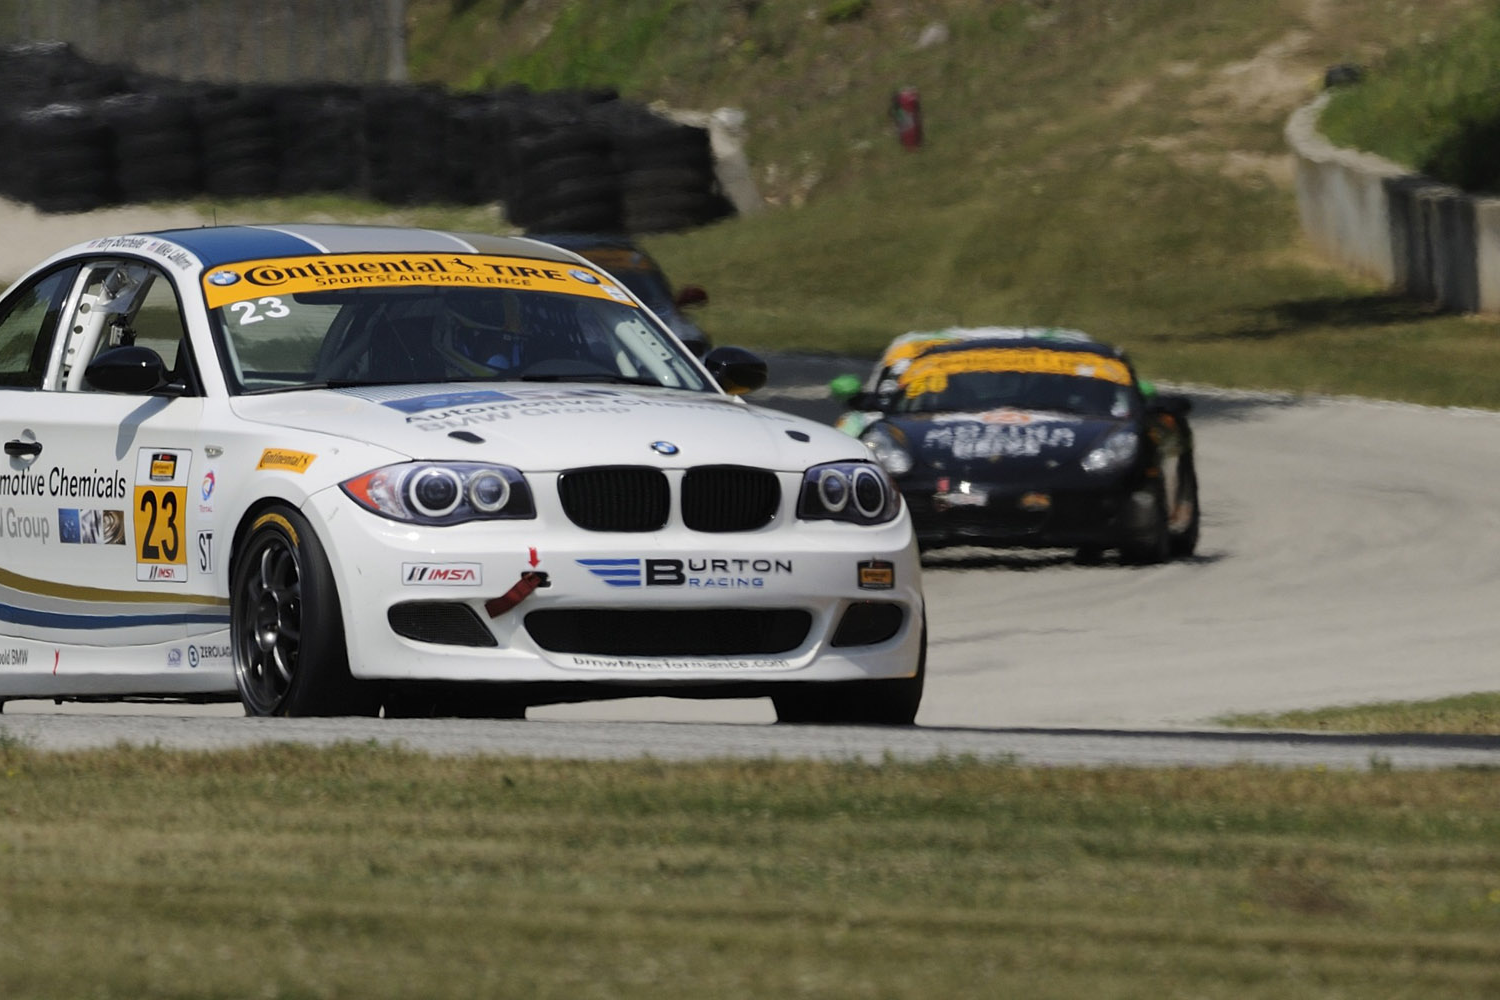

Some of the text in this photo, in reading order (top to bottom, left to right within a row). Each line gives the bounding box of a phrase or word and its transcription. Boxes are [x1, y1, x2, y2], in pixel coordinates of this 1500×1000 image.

[243, 258, 568, 287] Continental TIRE
[230, 296, 291, 326] 23
[49, 466, 126, 499] Chemicals
[6, 507, 50, 544] Group
[140, 490, 179, 562] 23
[200, 532, 213, 572] ST
[428, 569, 476, 581] IMSA
[645, 558, 794, 587] BURTON
[689, 577, 765, 588] RACING
[11, 648, 29, 665] BMW
[572, 656, 791, 671] bmwMperformance.com
